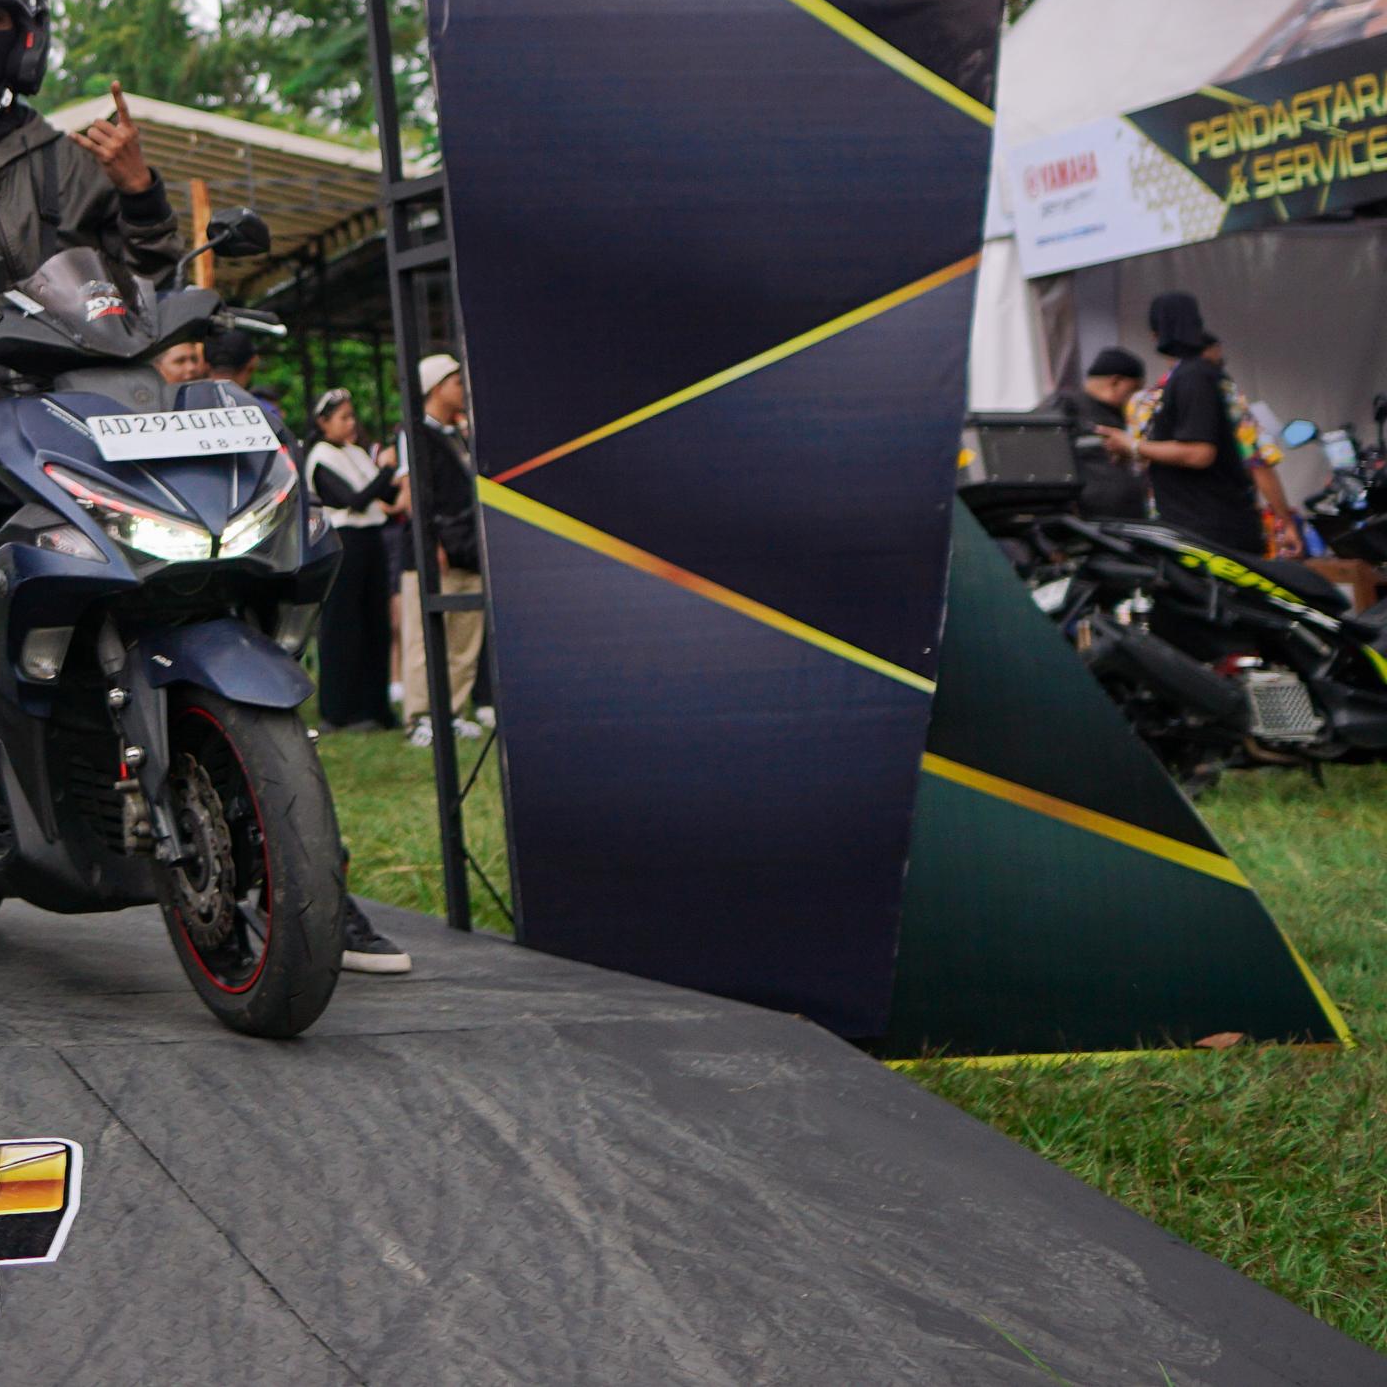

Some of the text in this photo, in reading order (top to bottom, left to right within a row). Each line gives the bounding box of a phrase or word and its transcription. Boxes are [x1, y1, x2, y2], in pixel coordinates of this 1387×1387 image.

[1188, 73, 1387, 165] PENDAFTAR
[1040, 151, 1098, 192] YAMAHA
[1252, 125, 1387, 199] SERVICE
